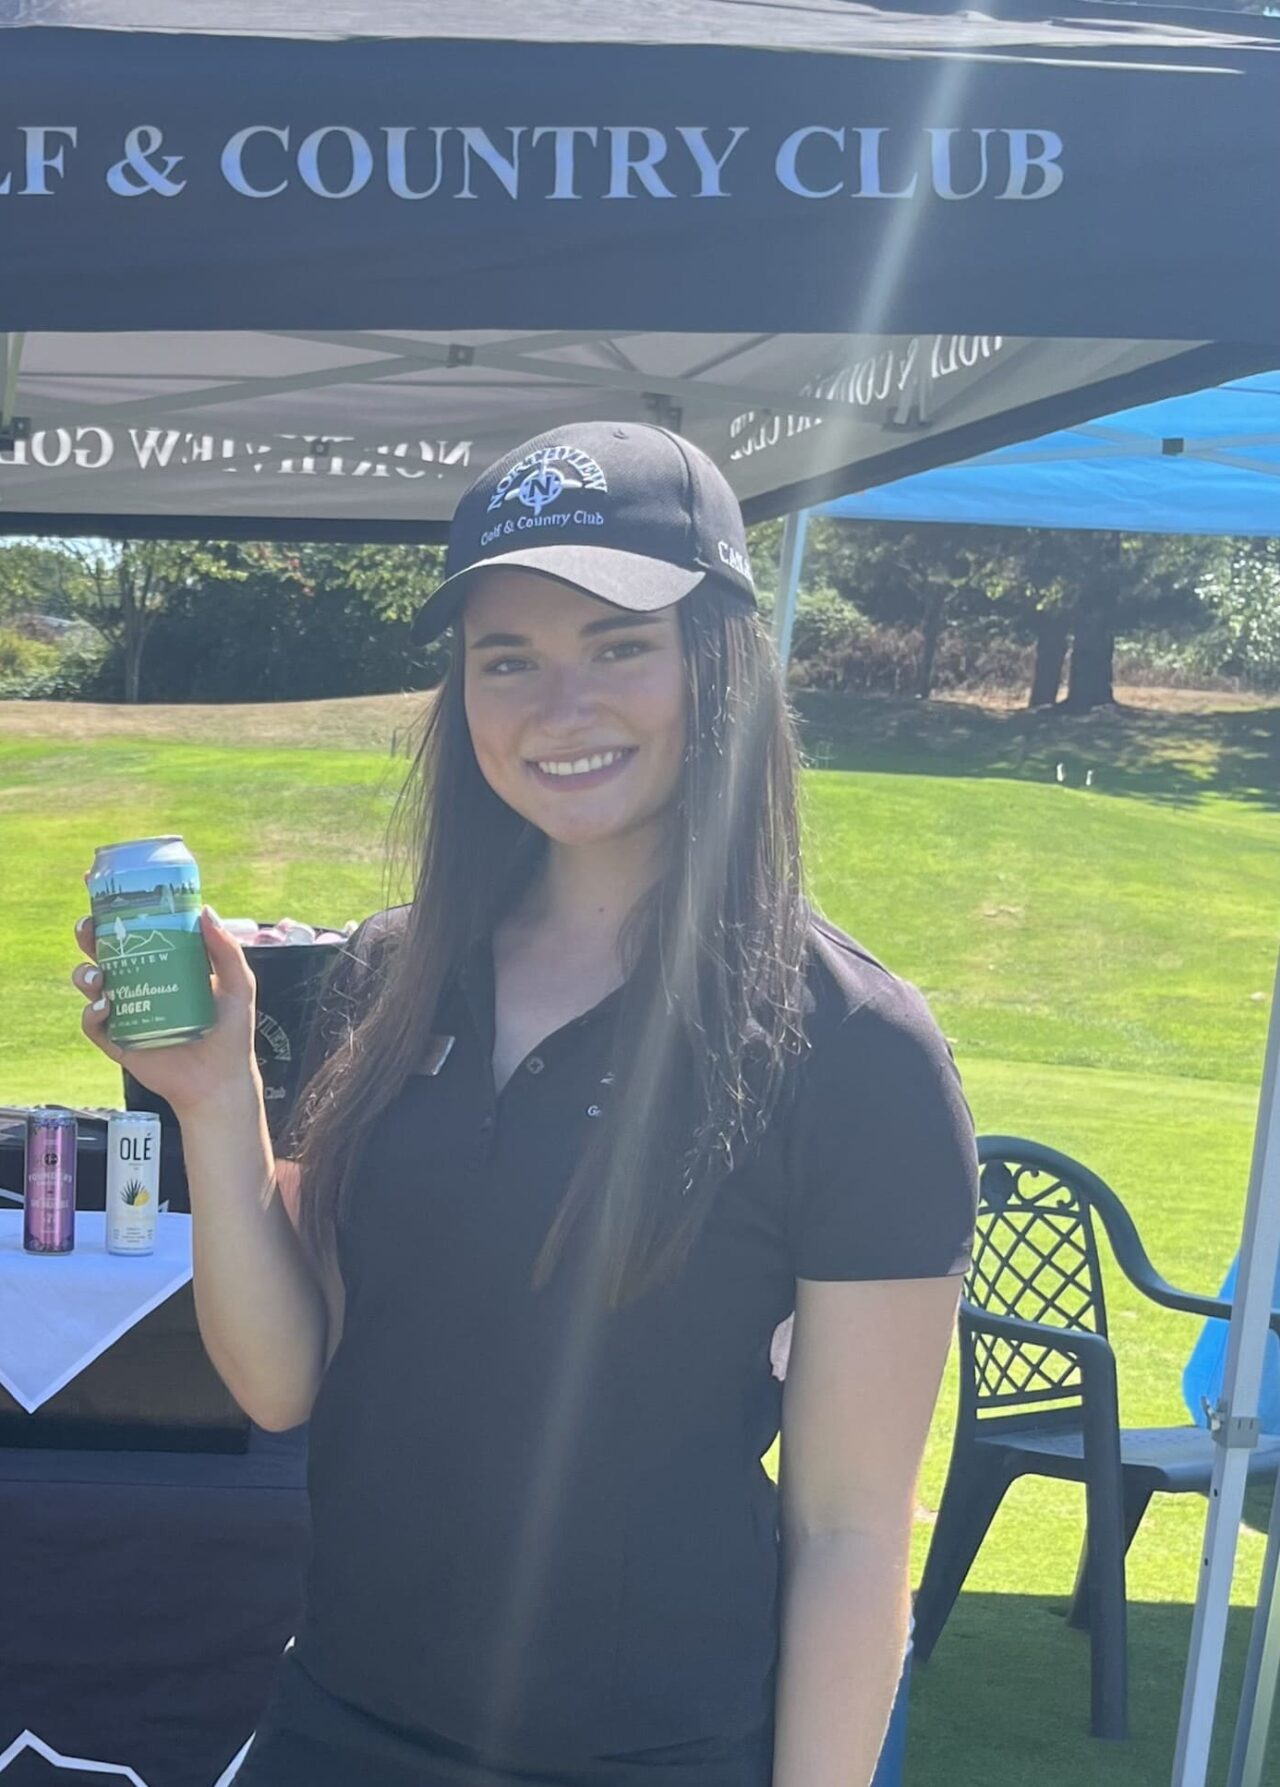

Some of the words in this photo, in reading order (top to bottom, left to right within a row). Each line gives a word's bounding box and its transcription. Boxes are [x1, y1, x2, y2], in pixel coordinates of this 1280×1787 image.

[106, 125, 187, 198] &
[220, 125, 750, 201] COUNTRY
[775, 125, 1065, 201] CLUB
[486, 445, 608, 513] NORTHVIEW
[479, 524, 503, 547] Golf
[503, 520, 514, 534] &
[516, 511, 571, 531] Country
[573, 509, 605, 526] Club
[117, 981, 180, 1001] Clubhouse
[116, 1000, 152, 1016] LAGER
[119, 1132, 152, 1161] OLÉ
